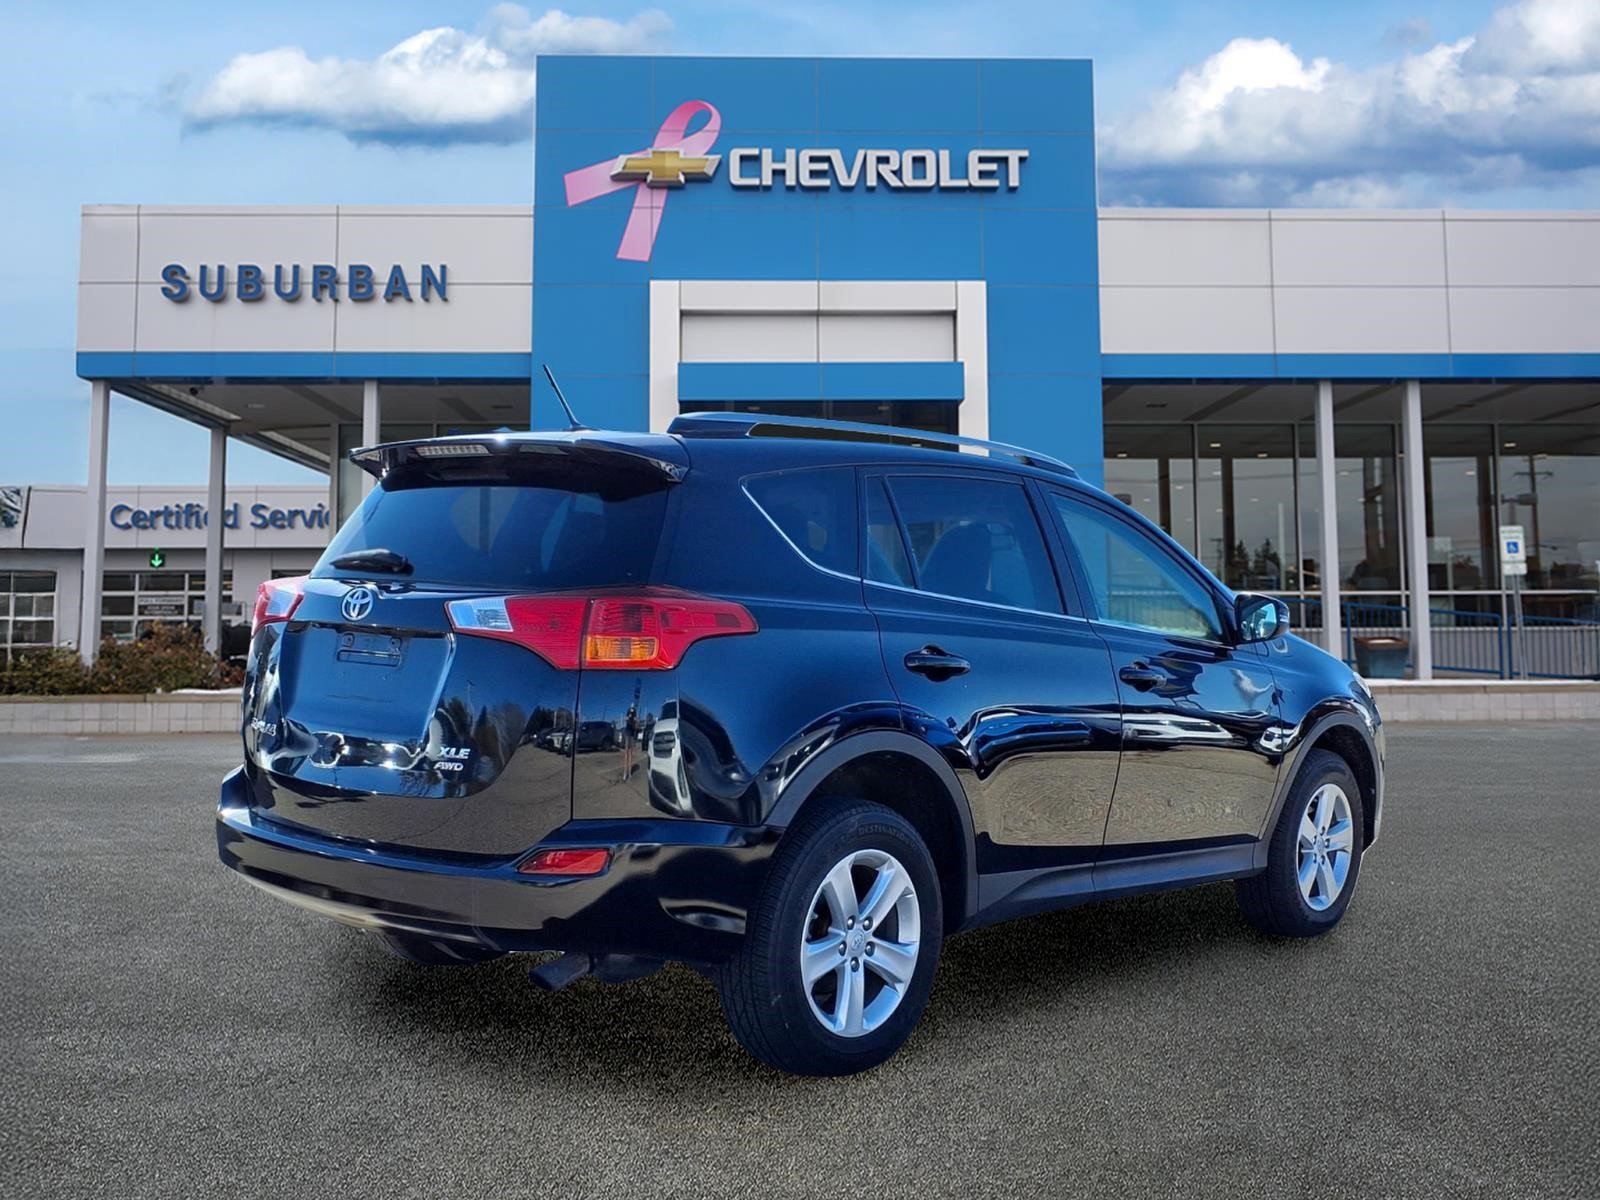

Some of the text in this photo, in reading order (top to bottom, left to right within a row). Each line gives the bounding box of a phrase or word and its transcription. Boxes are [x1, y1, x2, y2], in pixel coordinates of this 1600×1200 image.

[729, 148, 1029, 190] CHEVROLET
[160, 263, 448, 302] SUBURBAN
[437, 746, 471, 759] XLE
[433, 761, 464, 772] AWD
